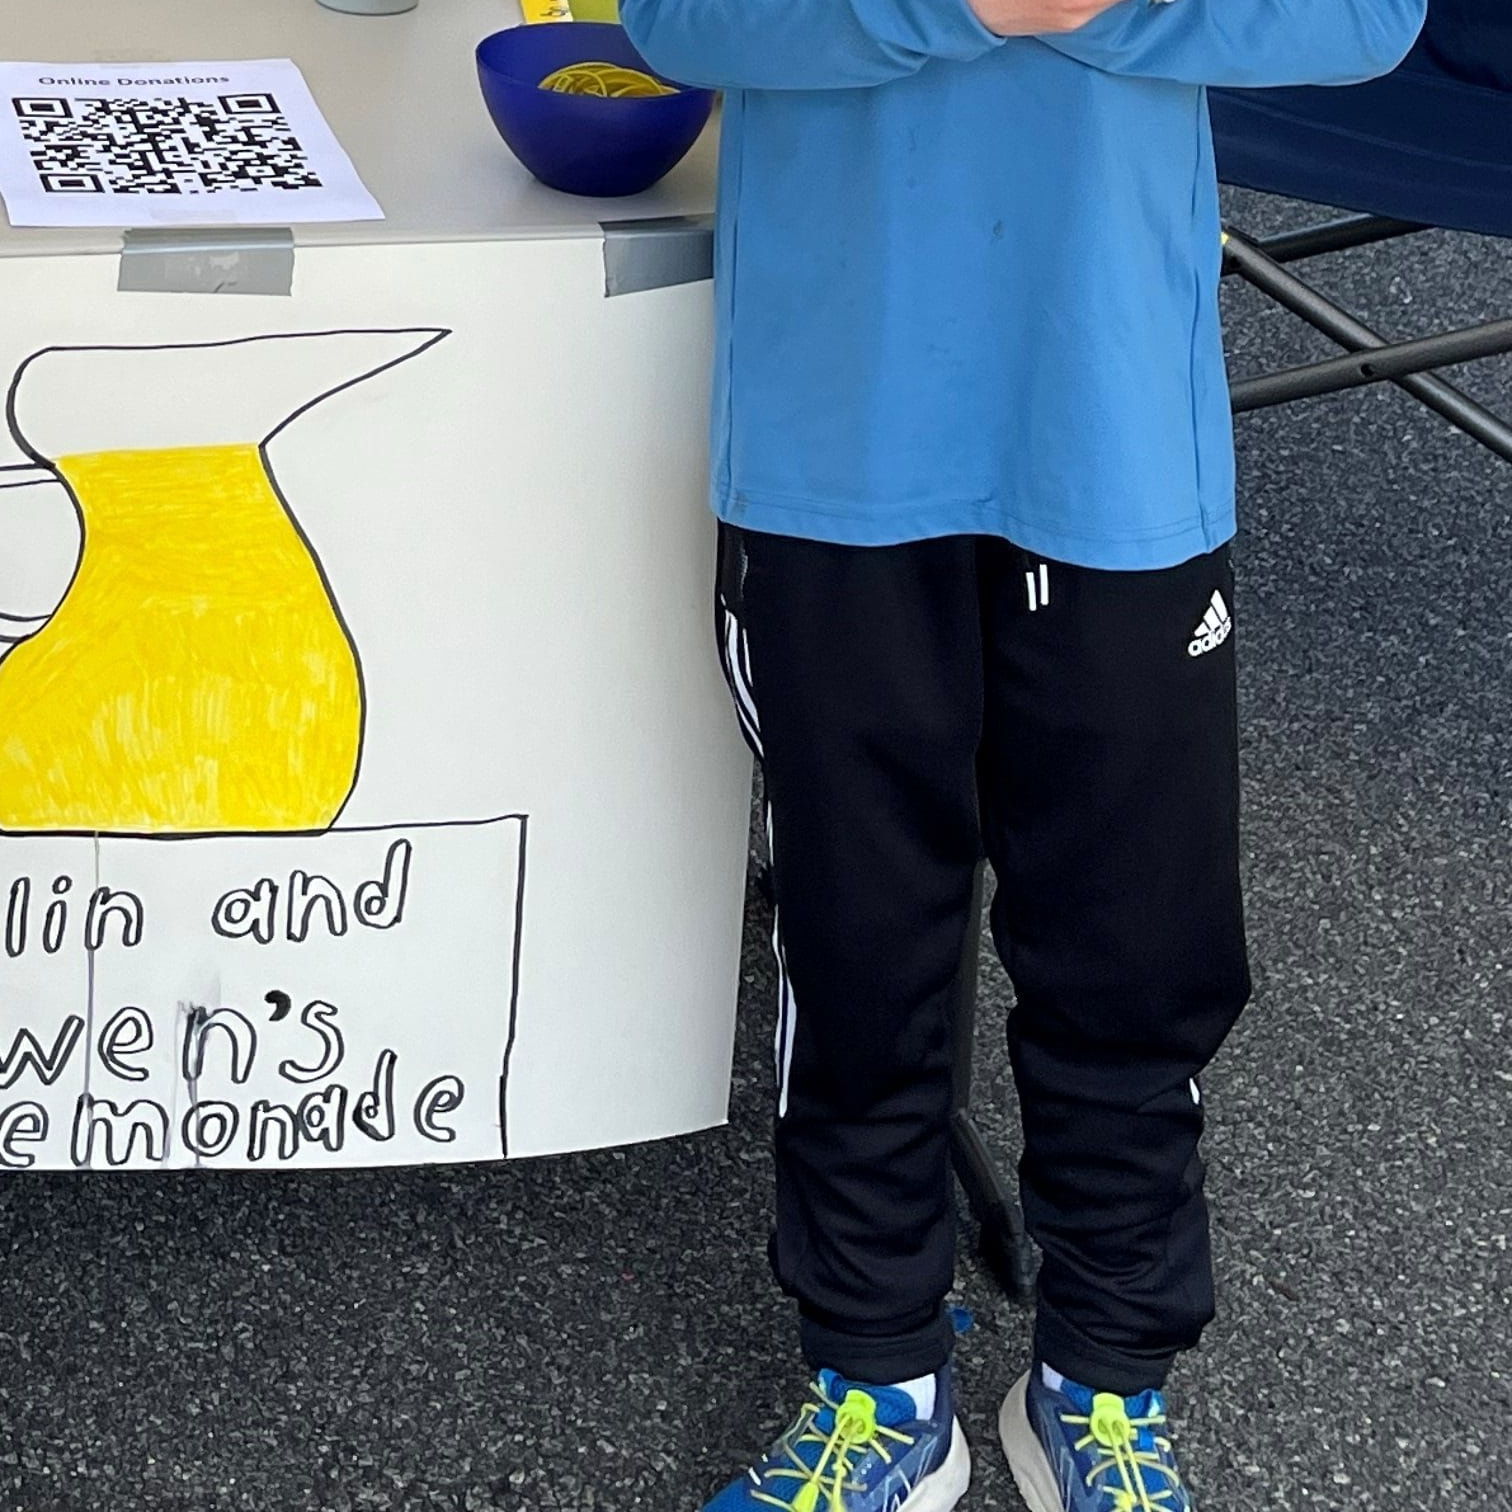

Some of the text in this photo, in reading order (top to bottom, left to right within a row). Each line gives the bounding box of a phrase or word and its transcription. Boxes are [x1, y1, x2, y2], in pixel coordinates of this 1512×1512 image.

[39, 76, 230, 86] Online Donations
[211, 838, 413, 945] and
